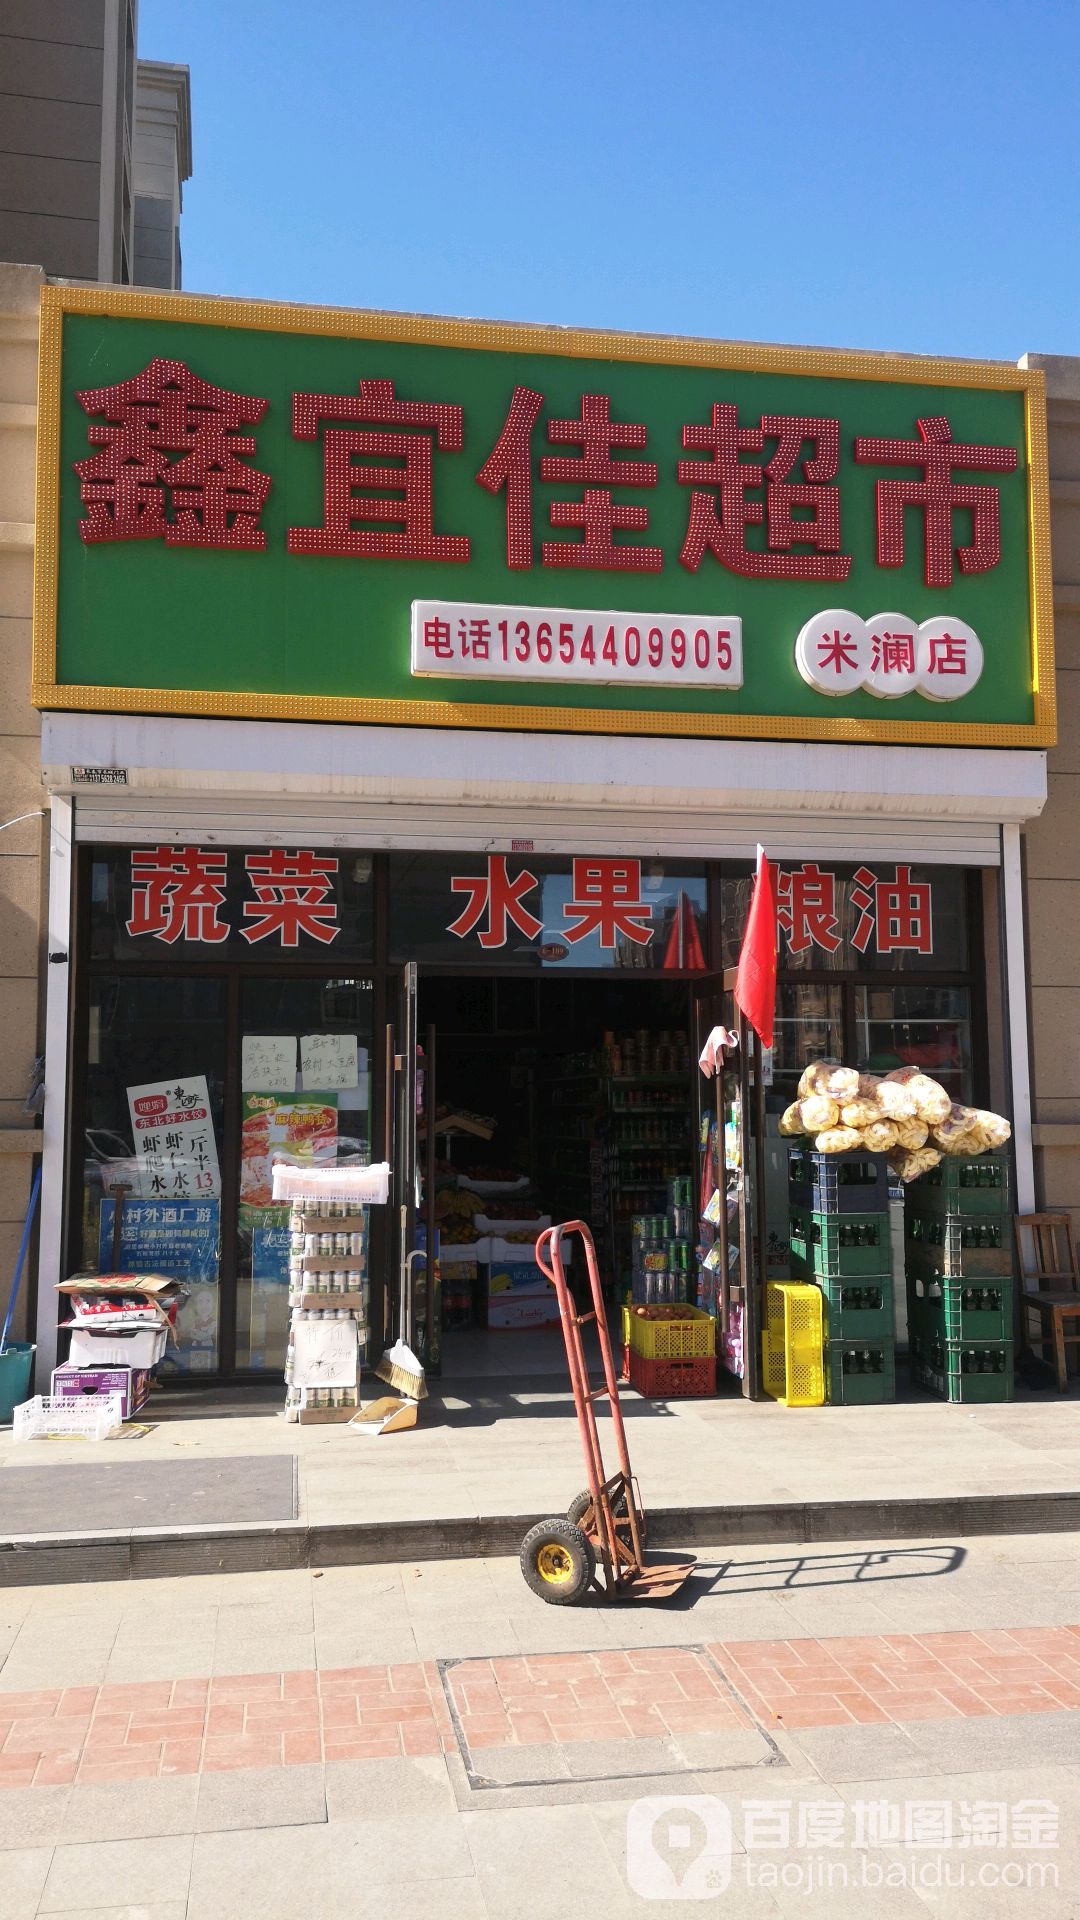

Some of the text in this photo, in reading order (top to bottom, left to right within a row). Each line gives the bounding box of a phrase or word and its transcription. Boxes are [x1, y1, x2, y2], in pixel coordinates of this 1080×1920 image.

[74, 356, 1018, 588] 鑫宜佳超市
[423, 616, 733, 670] 电话13654409905
[817, 630, 967, 675] 米澜店
[125, 846, 341, 947] 蔬菜
[446, 855, 655, 949] 水果
[139, 1109, 205, 1129] 东北好水饺
